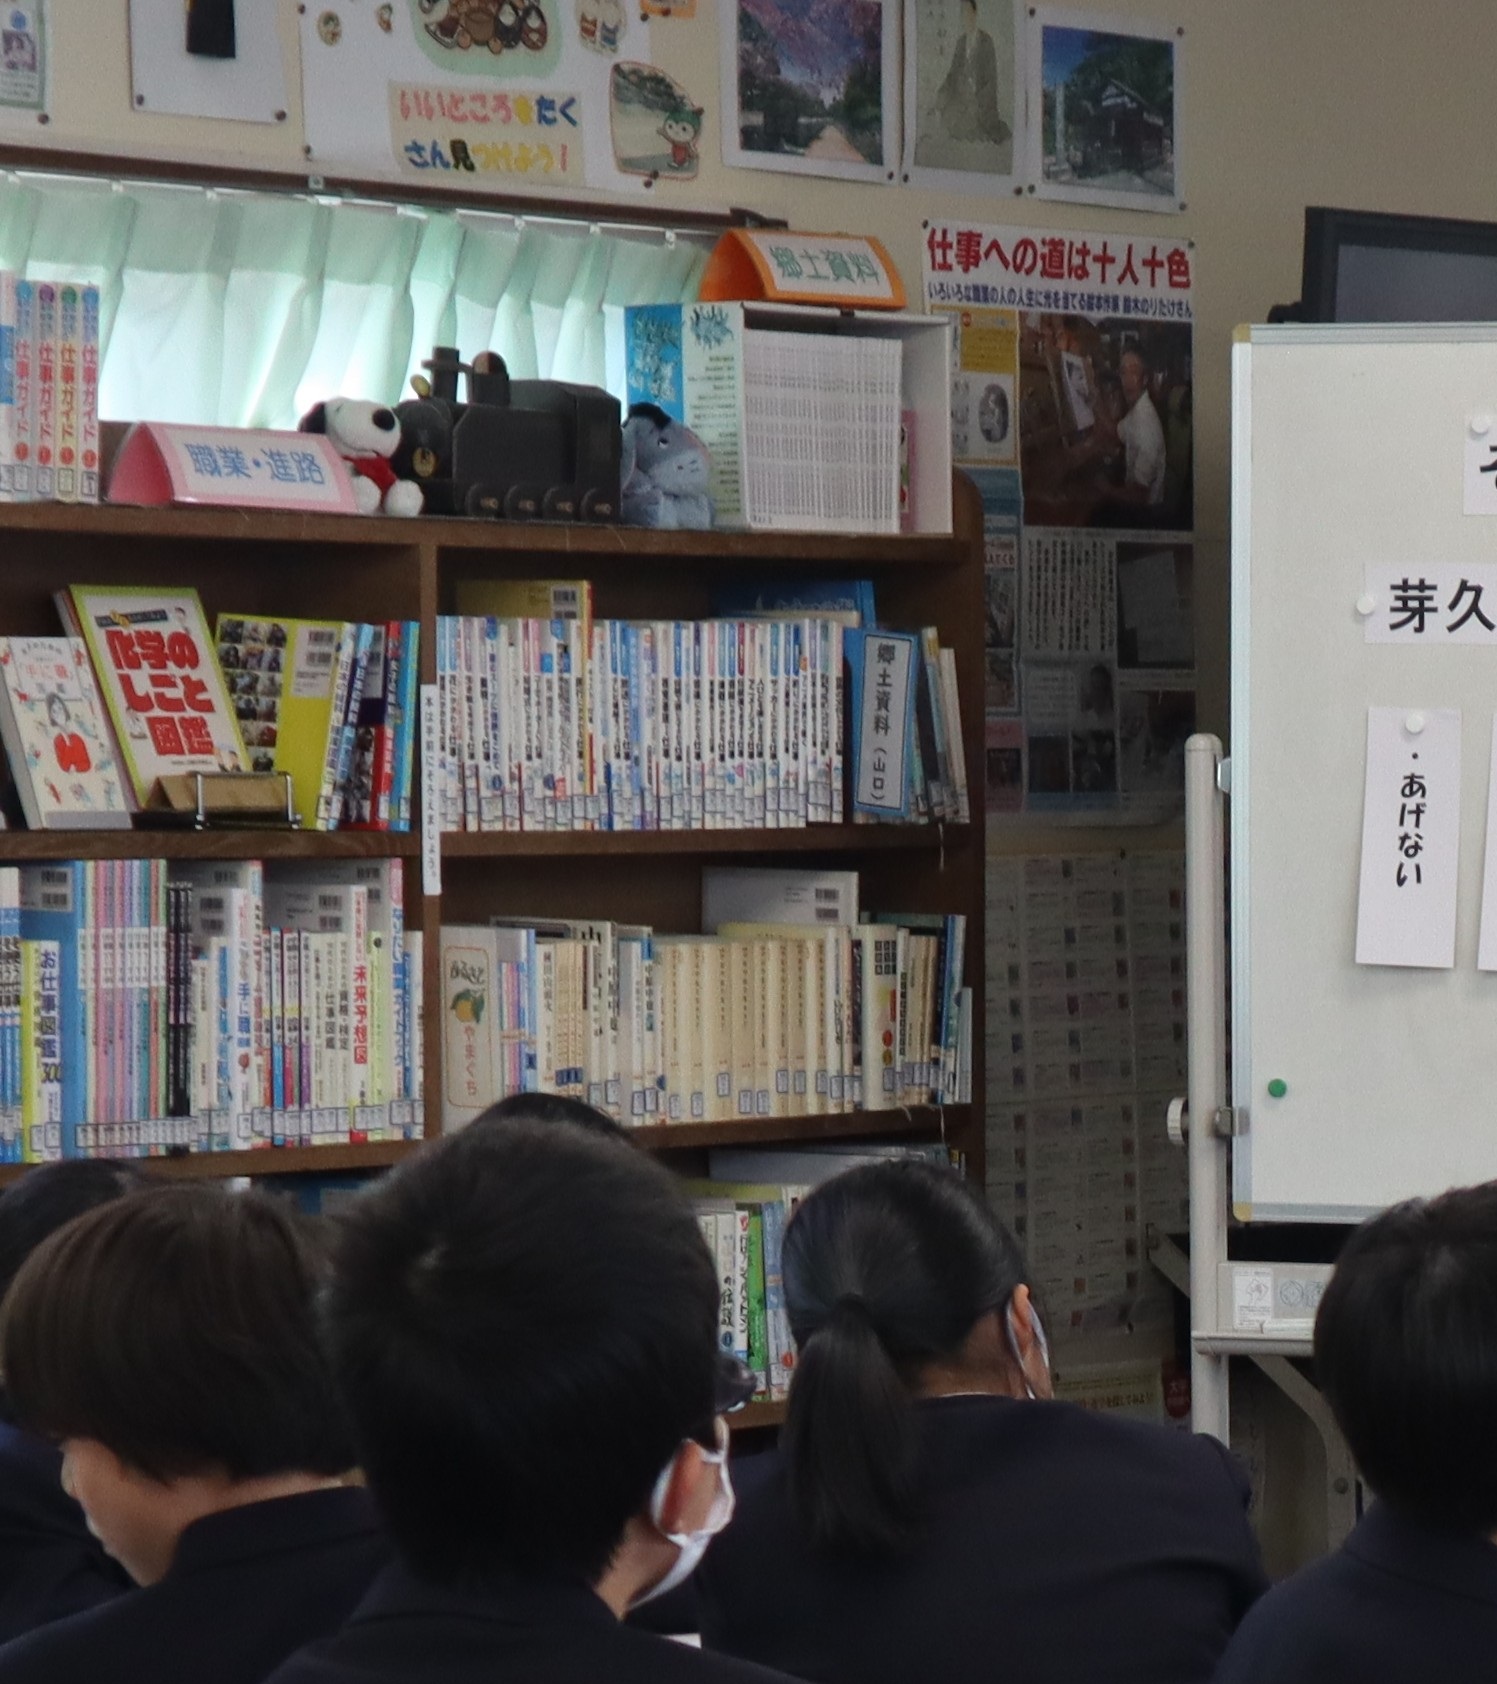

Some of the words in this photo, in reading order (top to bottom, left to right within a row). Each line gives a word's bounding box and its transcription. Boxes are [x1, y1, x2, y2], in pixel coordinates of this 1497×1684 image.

[928, 228, 1191, 289] 仕事への道は十人十色
[185, 444, 325, 484] 職業・進路
[105, 630, 200, 669] 化学の
[117, 672, 217, 713] しごと
[145, 716, 215, 756] 図鑑
[871, 643, 896, 801] 郷土資料（山口）
